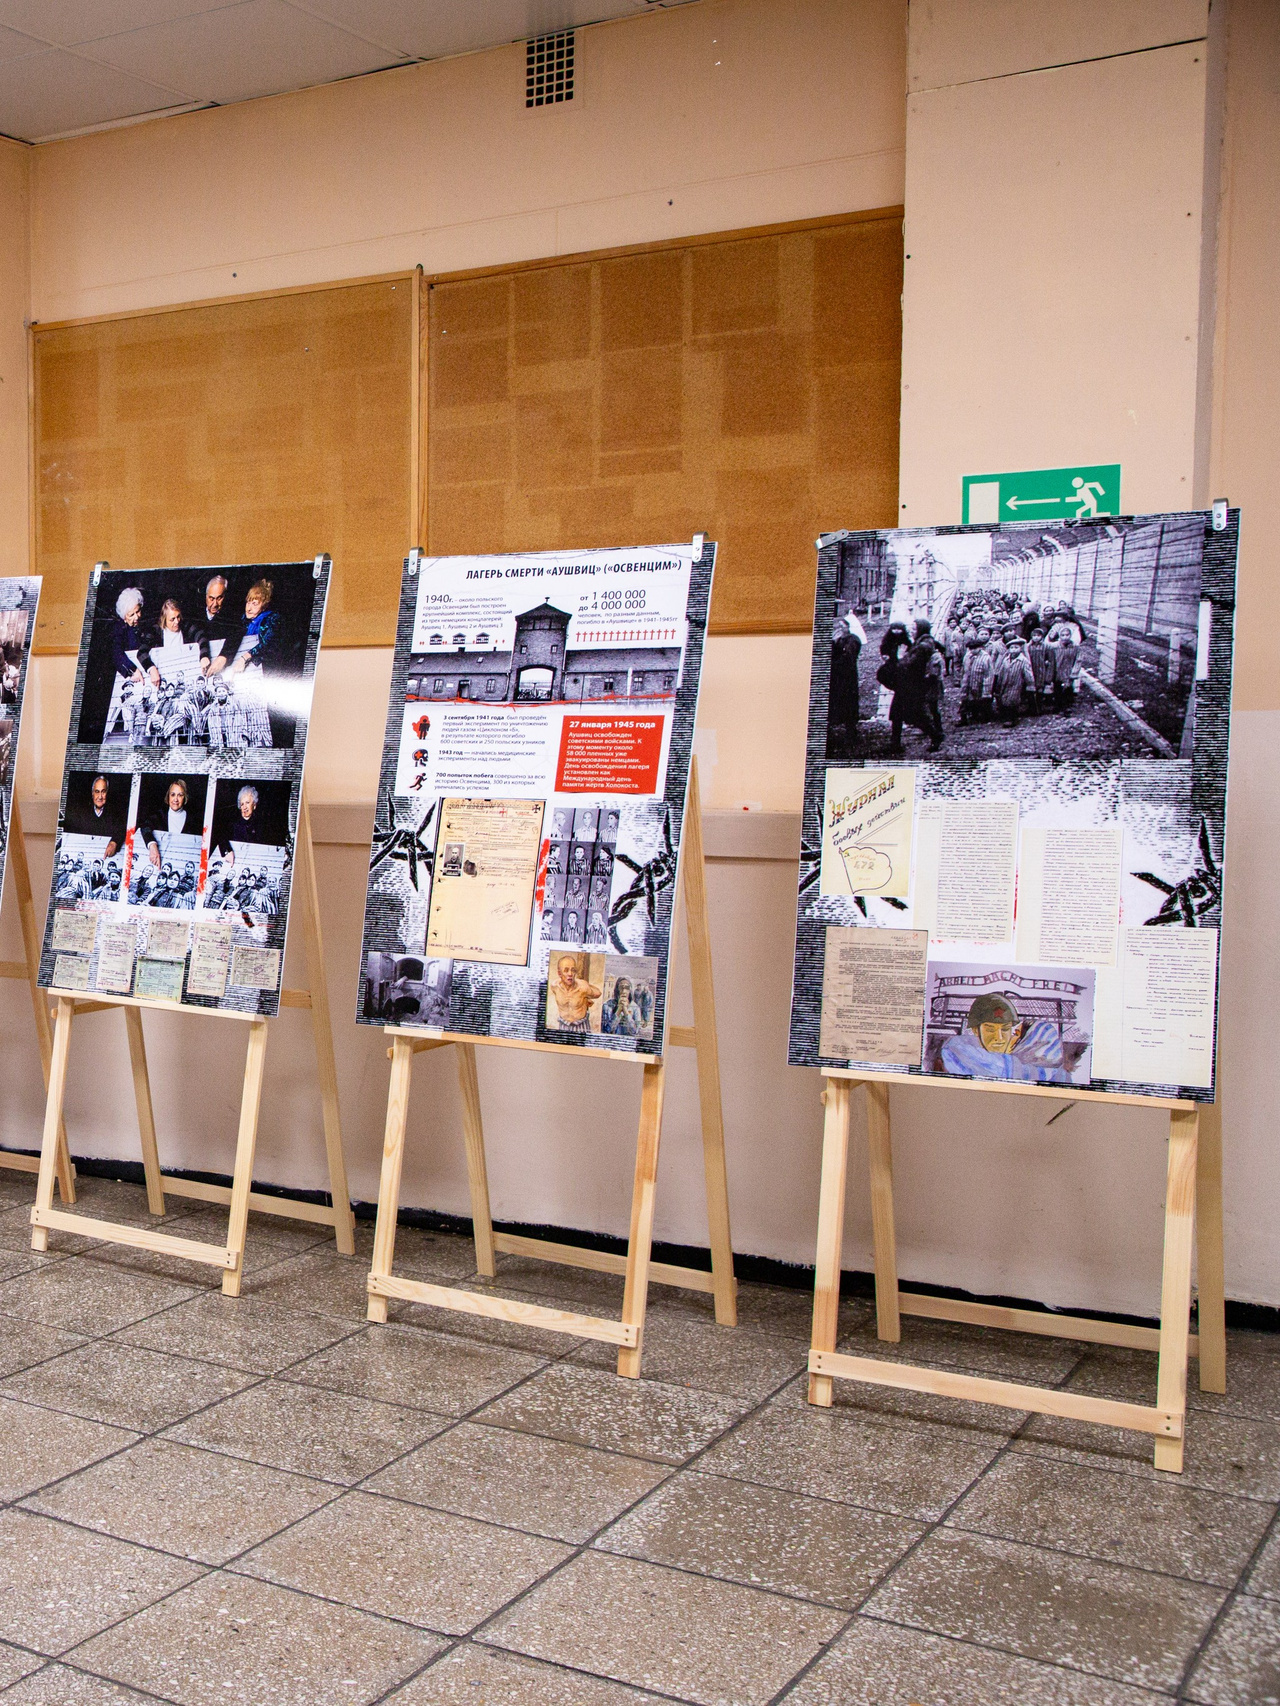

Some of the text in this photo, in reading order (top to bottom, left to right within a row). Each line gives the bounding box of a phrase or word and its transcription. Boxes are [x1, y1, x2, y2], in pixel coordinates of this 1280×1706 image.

[466, 560, 682, 579] ЛАГЕРЬ СМЕРТИ «АУШВИЦ» («ОСВЕНЦИМ»)
[425, 594, 454, 603] 1940г.
[592, 592, 597, 600] 1
[600, 591, 622, 600] 400
[624, 589, 646, 599] 000
[591, 601, 598, 610] 4
[601, 600, 622, 610] 000
[624, 600, 646, 609] 000
[940, 976, 975, 987] ARBEIT
[983, 971, 1023, 988] MACHT
